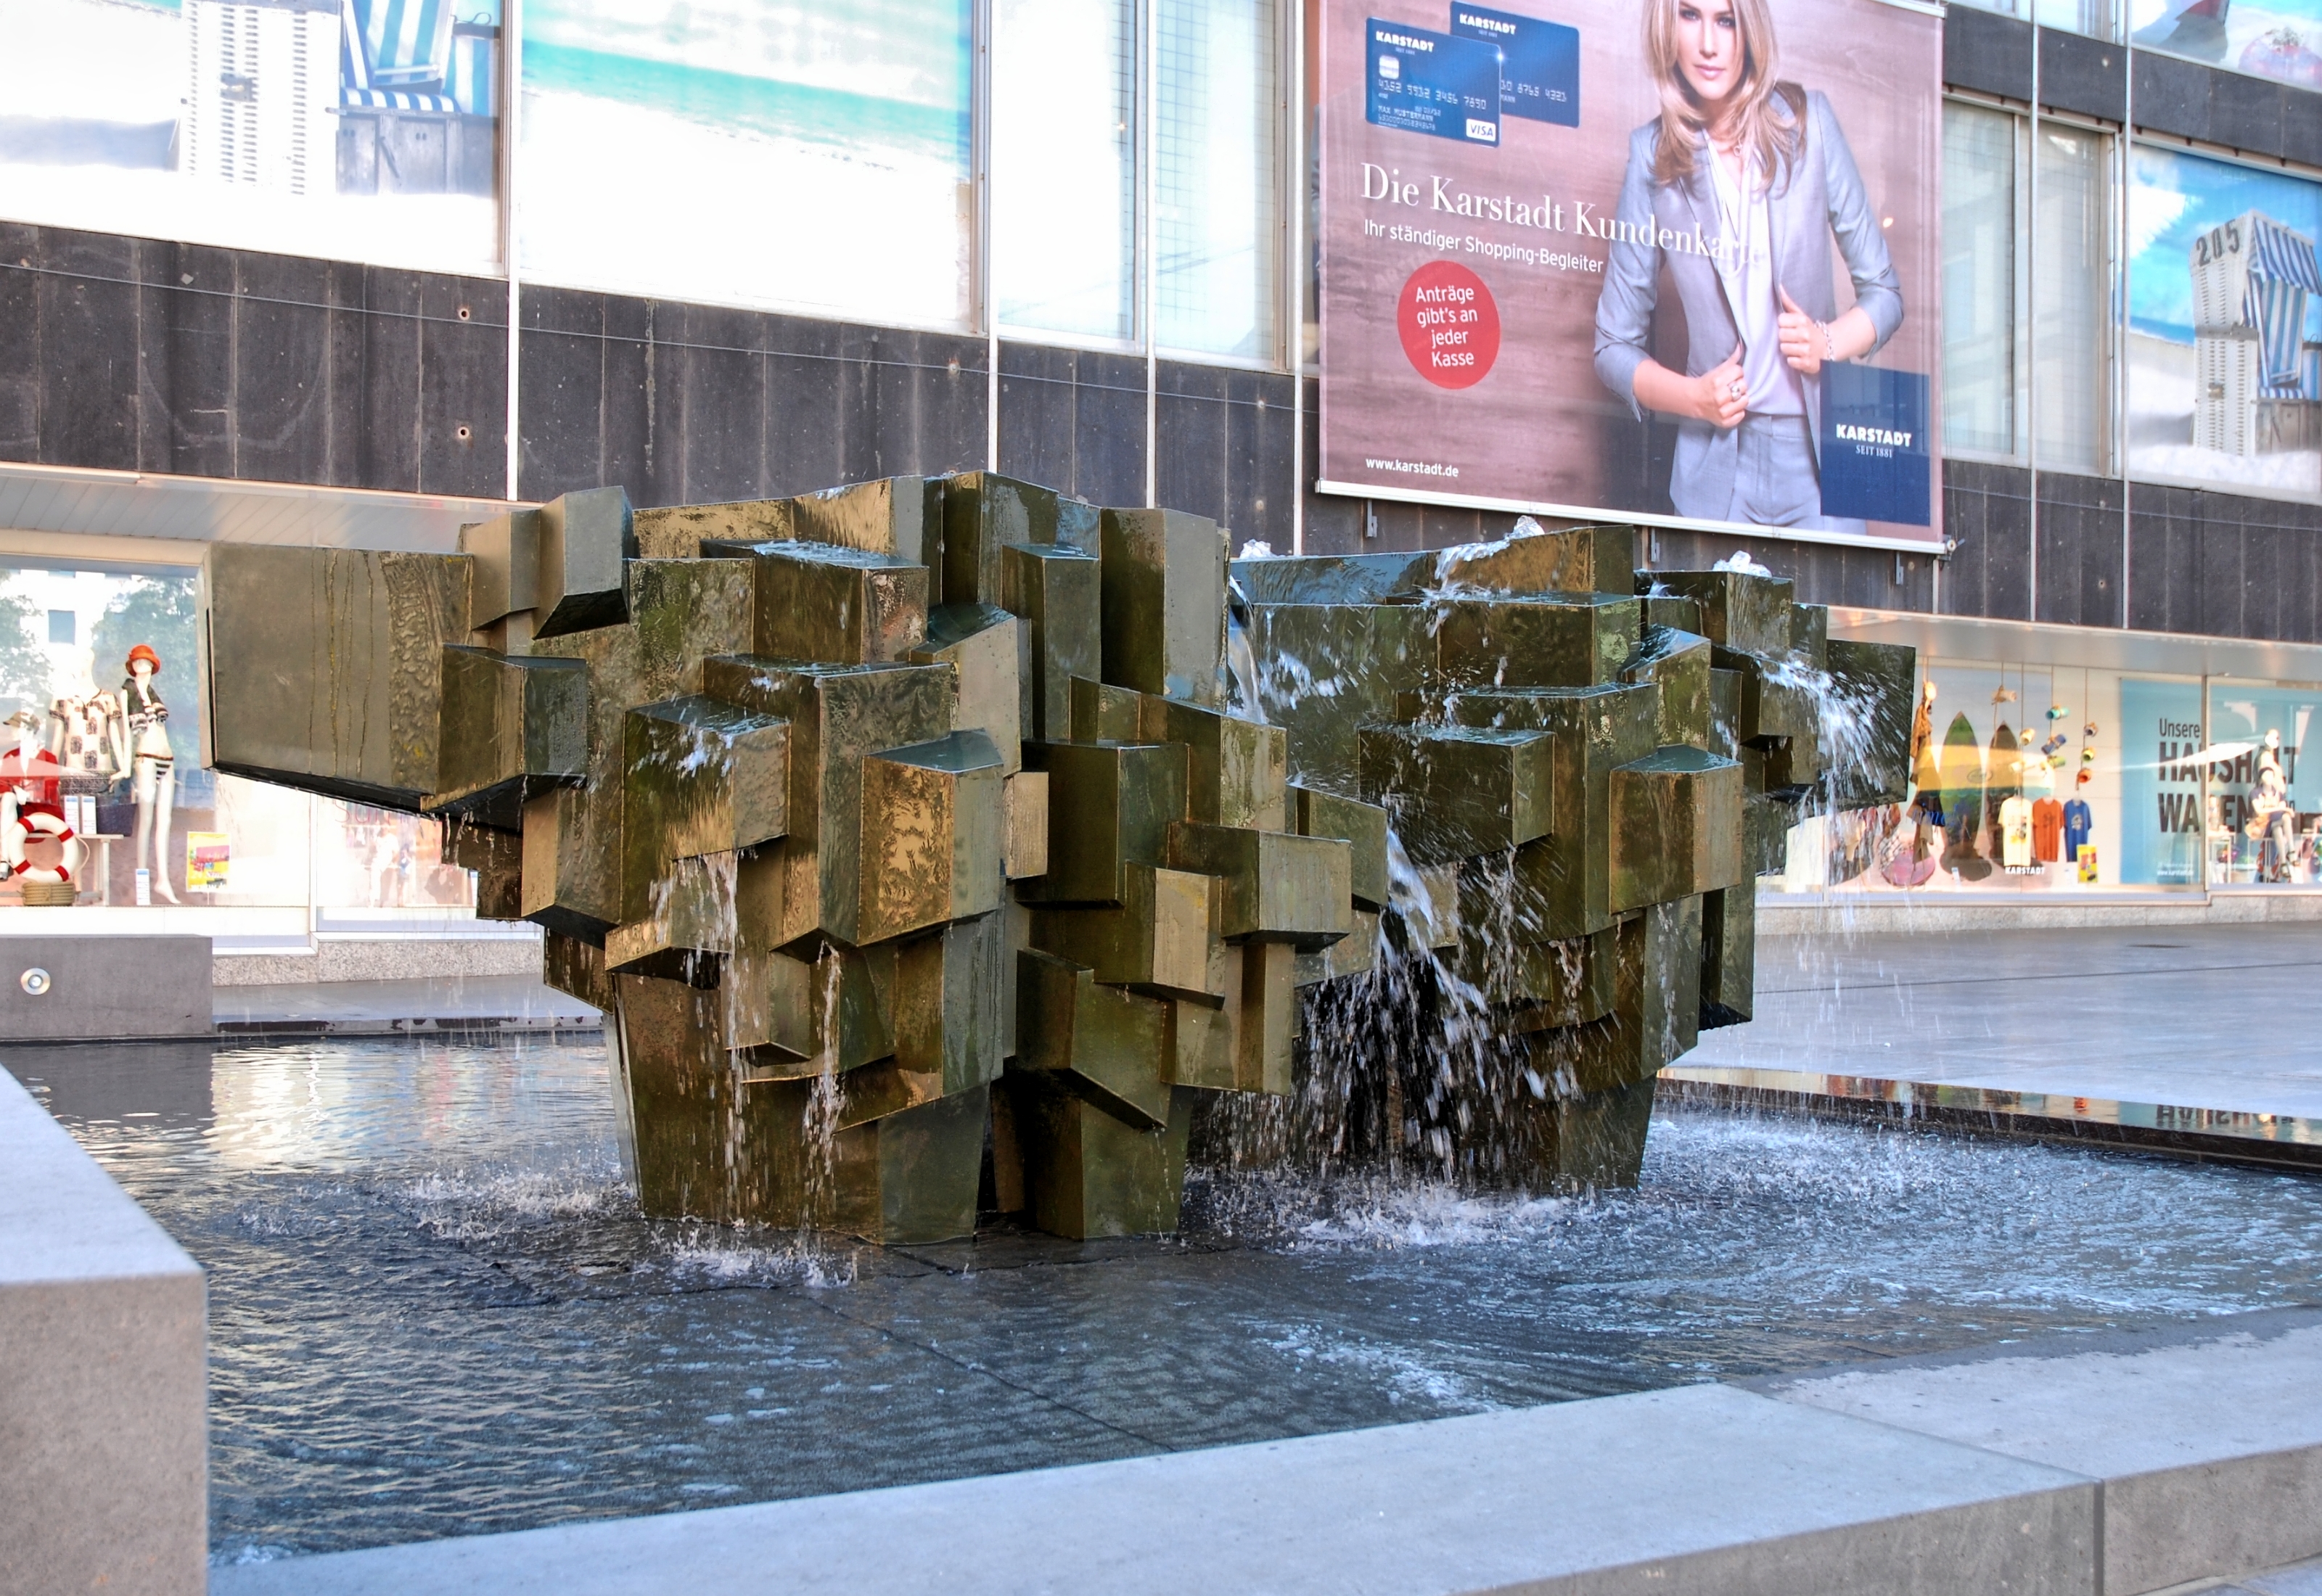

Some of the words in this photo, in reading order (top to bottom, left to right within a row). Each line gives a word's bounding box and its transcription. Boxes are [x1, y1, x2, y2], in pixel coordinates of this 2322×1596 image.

[1459, 13, 1516, 35] KARSTADT
[1376, 31, 1434, 52] KARSTADT
[1435, 90, 1459, 105] 3456
[1470, 123, 1493, 136] VISA
[1361, 163, 1419, 206] Die
[1429, 175, 1565, 231] Karstadt
[1364, 219, 1385, 237] Ihr
[1390, 224, 1461, 251] ständiger
[1465, 236, 1603, 272] Shopping-Begleiter
[2196, 218, 2239, 266] 205
[1416, 285, 1474, 304] Anträge
[1417, 308, 1456, 328] gibt's
[1460, 308, 1477, 322] an
[1431, 329, 1468, 349] jeder
[1431, 351, 1474, 367] Kasse
[1836, 424, 1911, 447] KARSTADT
[1855, 444, 1874, 456] SEIT
[1876, 447, 1892, 458] 1881
[1365, 458, 1459, 477] www.karstadt.de
[2159, 718, 2200, 738] Unsere
[2158, 793, 2255, 834] WAEN
[2005, 866, 2046, 875] KARSTADT
